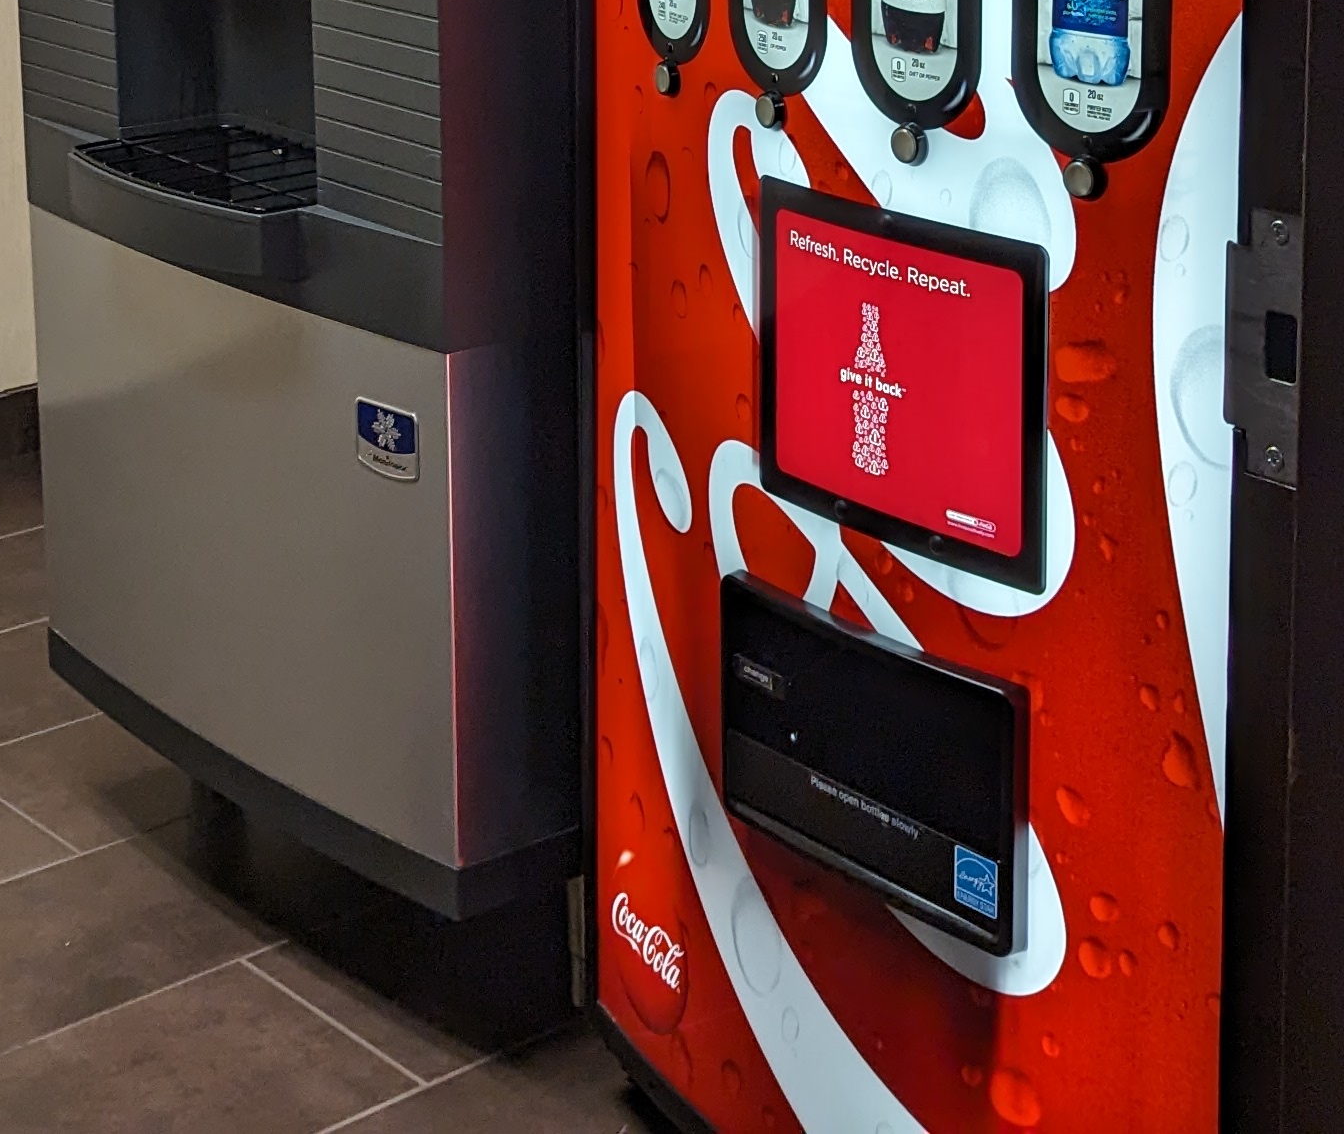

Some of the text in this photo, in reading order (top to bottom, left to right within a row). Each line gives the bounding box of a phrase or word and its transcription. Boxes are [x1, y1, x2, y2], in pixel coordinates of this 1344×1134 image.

[1069, 92, 1074, 102] 0
[1088, 89, 1096, 99] 20
[789, 230, 971, 297] Refresh. Recycle. Repeat.
[840, 367, 862, 384] give
[864, 373, 873, 388] it
[811, 774, 837, 797] Please
[838, 791, 860, 808] open
[612, 892, 685, 990] Coca-Cola
